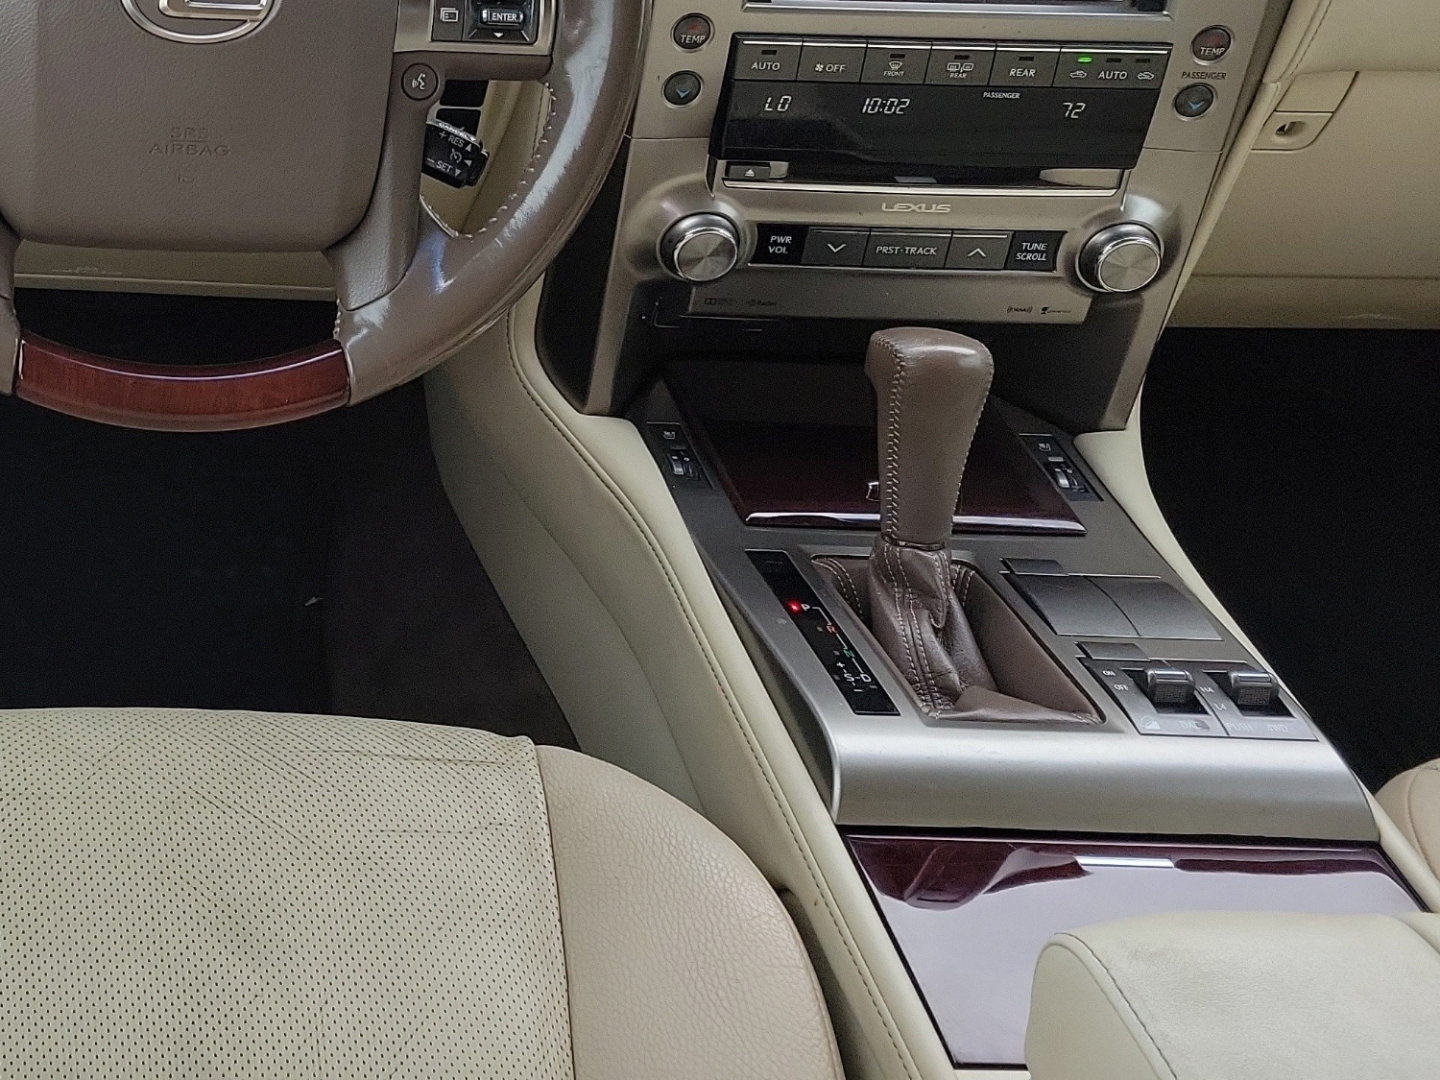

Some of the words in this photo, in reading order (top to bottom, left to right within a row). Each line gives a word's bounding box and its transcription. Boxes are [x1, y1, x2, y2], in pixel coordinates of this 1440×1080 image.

[491, 12, 517, 22] ENTER
[679, 34, 706, 44] TEMP
[1199, 46, 1225, 56] TEMP
[750, 61, 781, 71] AUTO
[825, 64, 847, 73] OFF
[883, 70, 905, 78] FRONT
[1009, 67, 1036, 78] REAR
[1097, 70, 1128, 80] AUTO
[1181, 71, 1227, 81] PASSENGER
[982, 91, 1021, 99] PASSENGER
[861, 97, 910, 115] 10:02
[1062, 101, 1087, 119] 72
[148, 143, 231, 156] AIRBAG
[881, 202, 952, 213] LEXUS
[769, 235, 792, 244] PWR
[768, 245, 789, 254] VOL
[1021, 242, 1048, 251] TUNE
[1015, 251, 1048, 261] SCROLL
